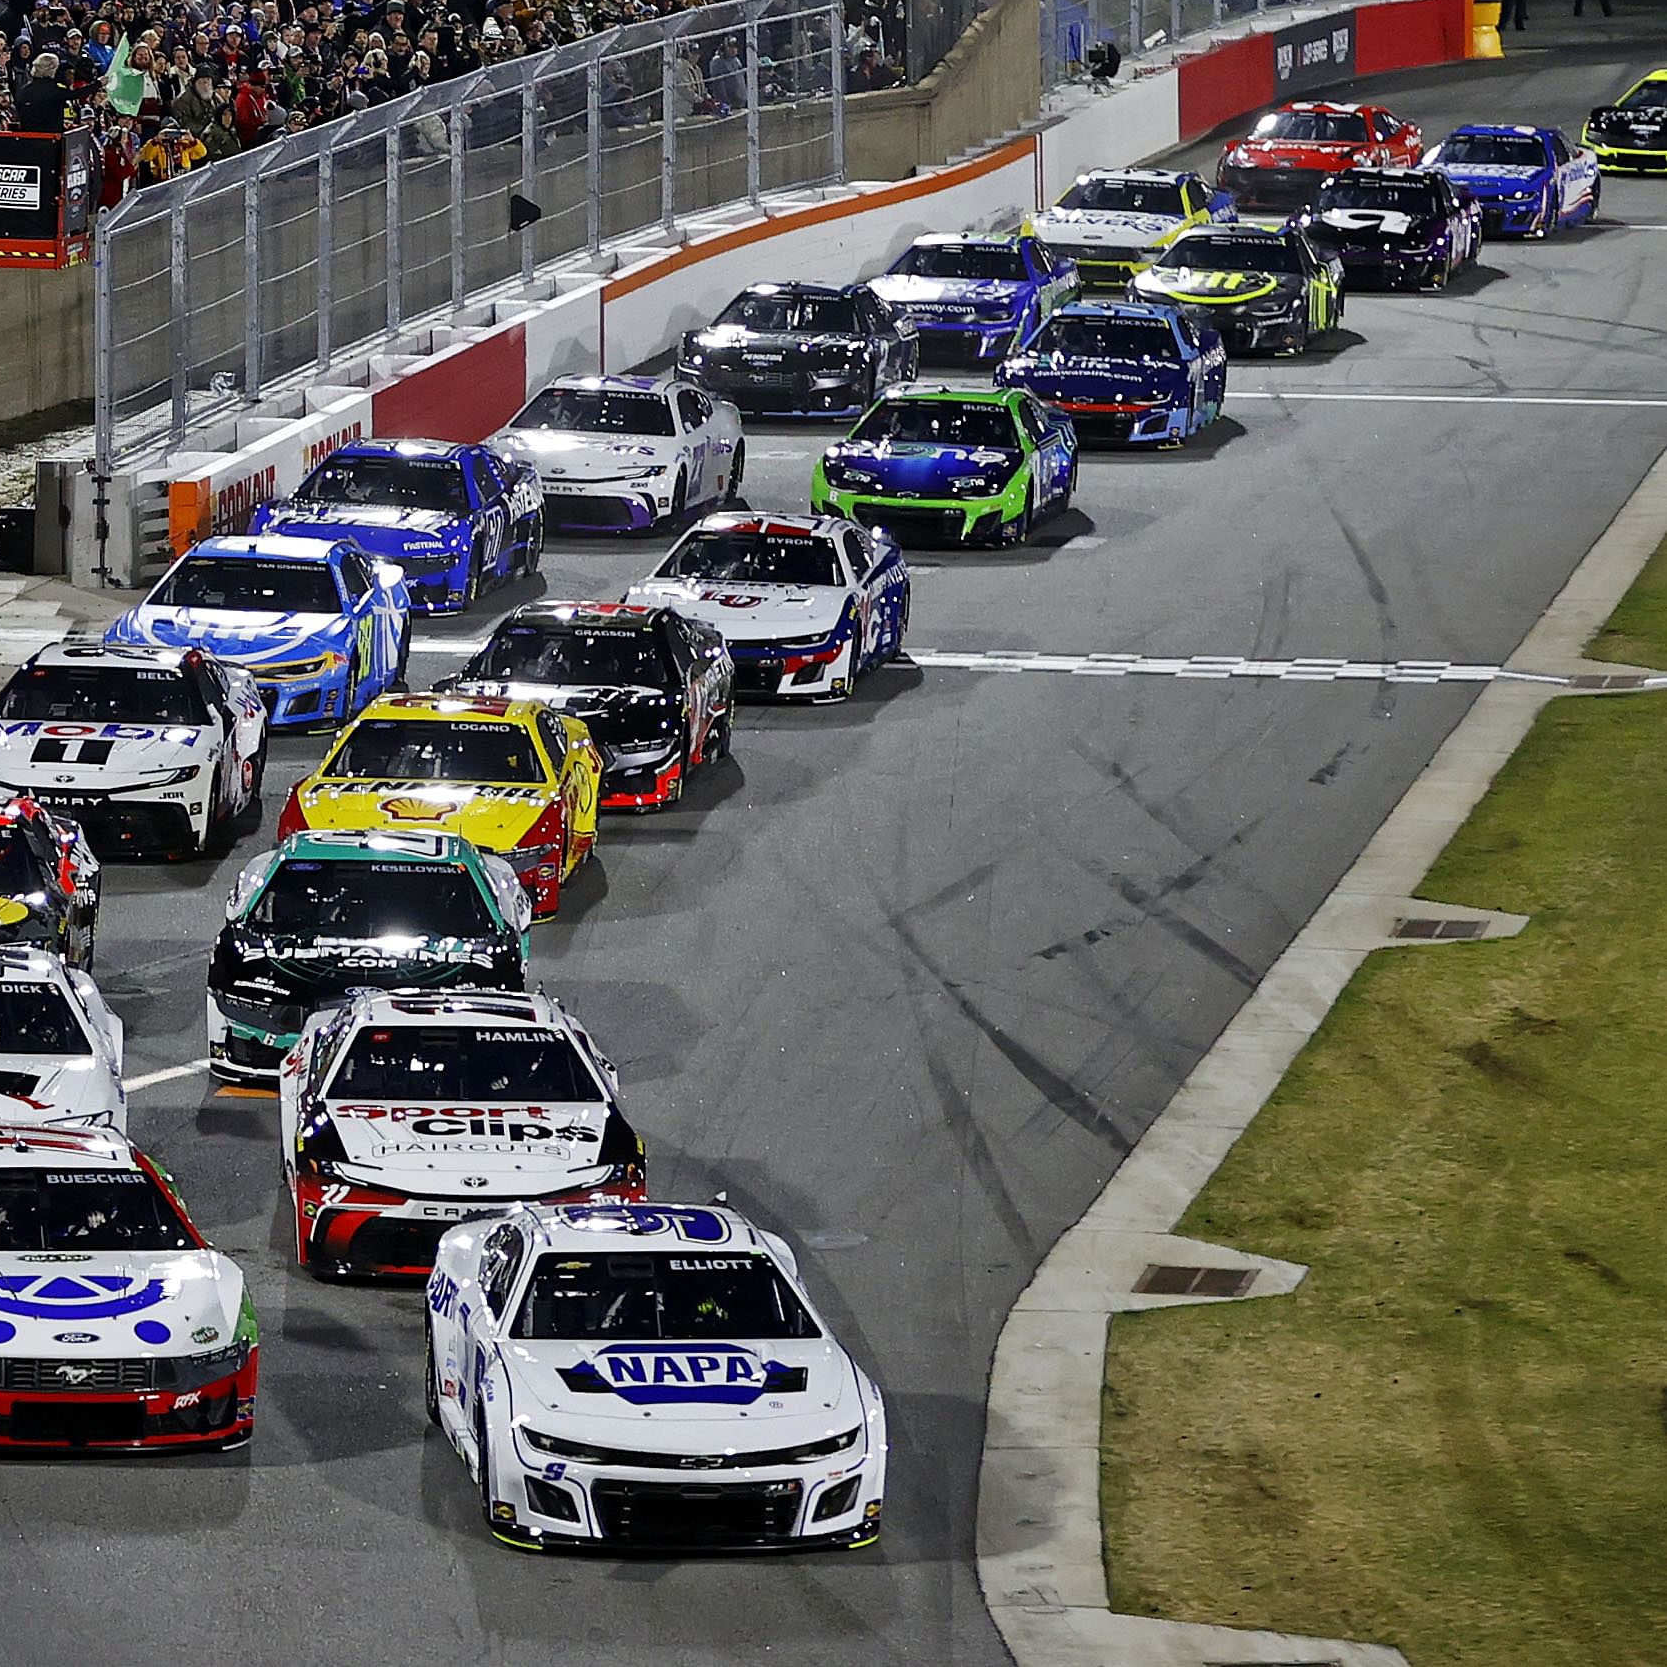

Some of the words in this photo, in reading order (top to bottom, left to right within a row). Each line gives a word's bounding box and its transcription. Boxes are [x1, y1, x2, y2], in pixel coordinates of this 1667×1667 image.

[607, 392, 659, 401] WALLACE
[963, 404, 1005, 413] BUSCH
[403, 541, 446, 551] FASTENAL
[767, 536, 814, 546] BYRON
[575, 628, 636, 638] GRAGSON
[136, 671, 176, 681] BELL
[450, 722, 511, 733] LOGANO
[61, 739, 85, 762] 1
[38, 796, 104, 807] AMRY
[158, 791, 185, 800] JGR
[371, 863, 463, 875] KESELOWSKI
[242, 944, 494, 969] SUBMARINES
[337, 958, 398, 970] .COM
[475, 1031, 554, 1043] HAMLIN
[335, 1104, 552, 1122] Sport
[412, 1118, 600, 1143] Clips
[381, 1142, 562, 1156] HAIRCUTS
[46, 1172, 147, 1185] BUESCHER
[669, 1258, 754, 1271] ELLIOTT
[61, 1332, 92, 1343] Ford
[609, 1354, 763, 1384] NAPA
[173, 1390, 202, 1410] RFK
[542, 1462, 567, 1481] 9
